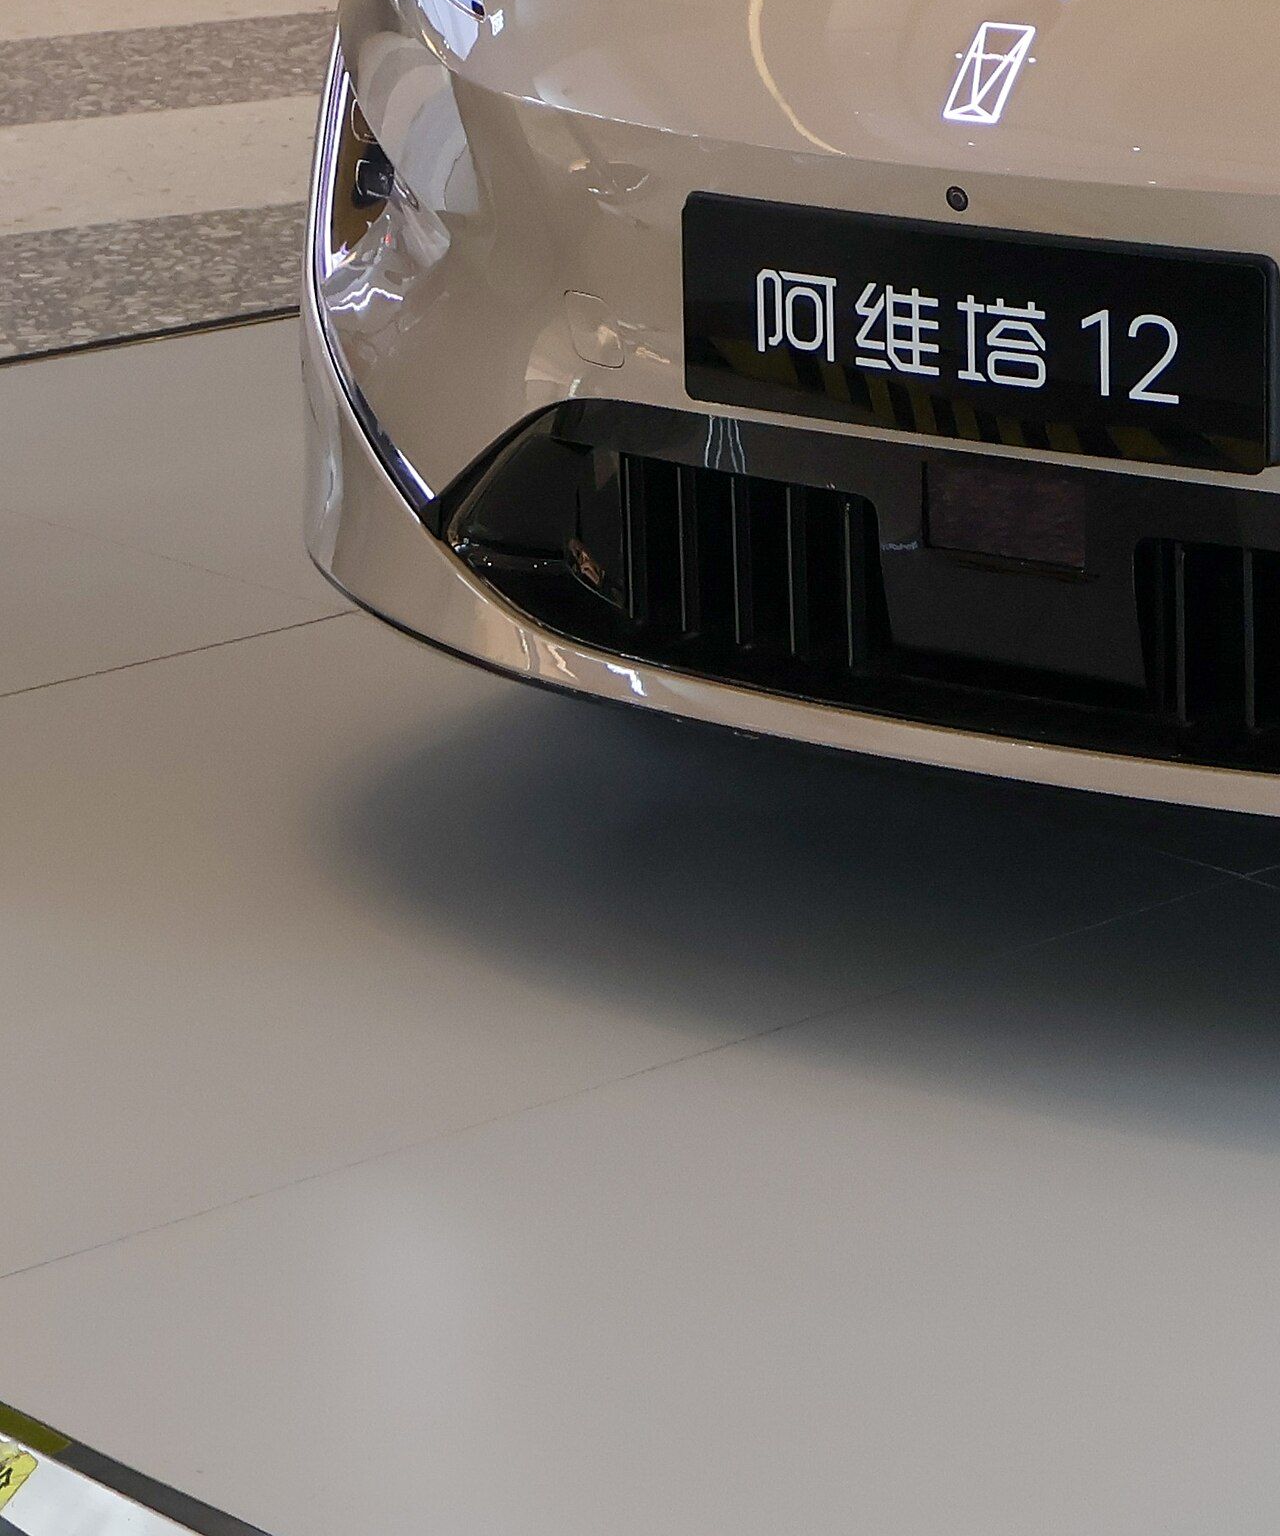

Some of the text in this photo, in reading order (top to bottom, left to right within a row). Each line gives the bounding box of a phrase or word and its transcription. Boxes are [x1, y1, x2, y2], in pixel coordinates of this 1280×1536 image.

[756, 268, 1180, 405] 阿维塔 12
